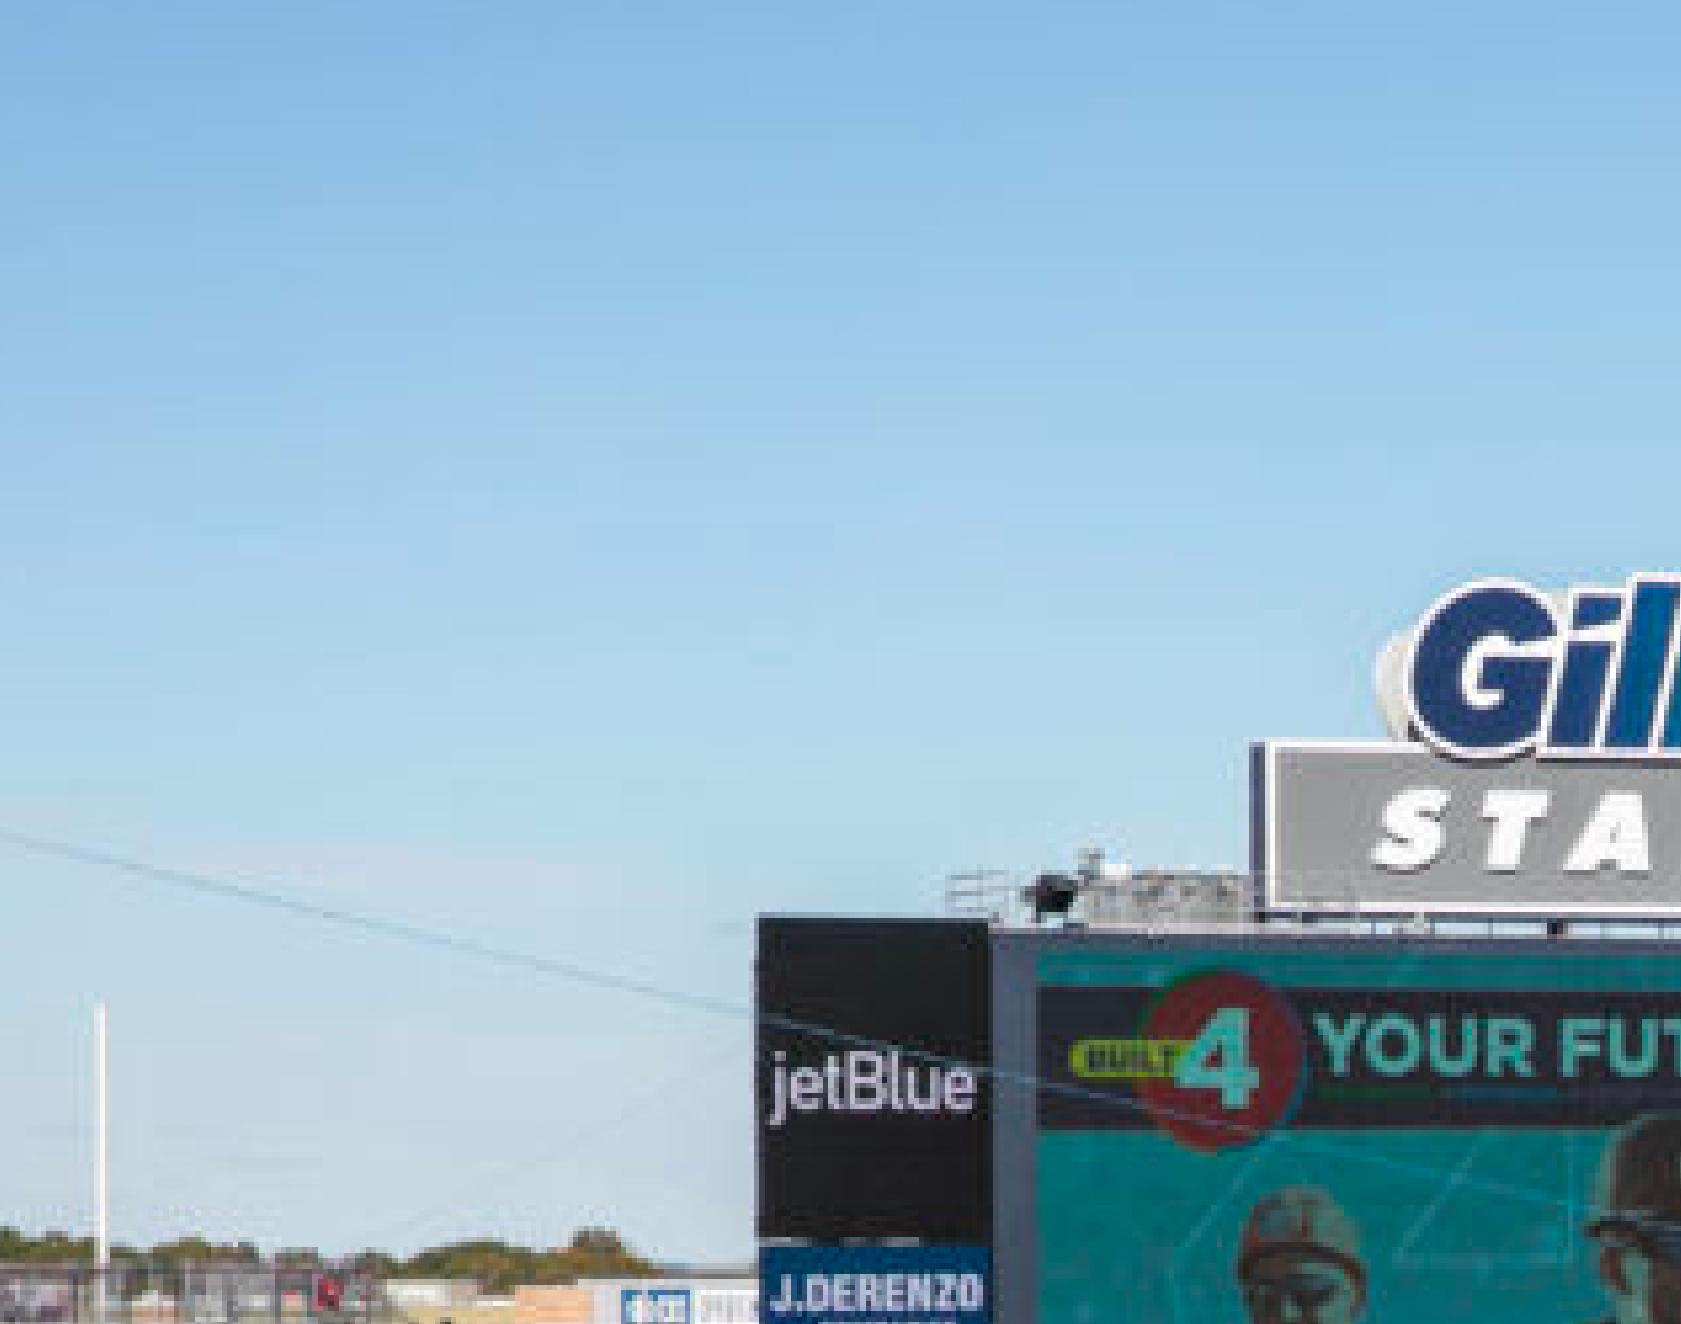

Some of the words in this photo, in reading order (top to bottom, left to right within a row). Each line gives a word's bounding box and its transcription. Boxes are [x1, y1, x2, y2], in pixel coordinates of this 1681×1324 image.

[767, 1050, 977, 1125] jetBlue
[1083, 1046, 1175, 1073] BUILT
[1173, 1007, 1260, 1109] 4
[1314, 1017, 1538, 1079] YOUR
[770, 1273, 984, 1312] J.DERENZO
